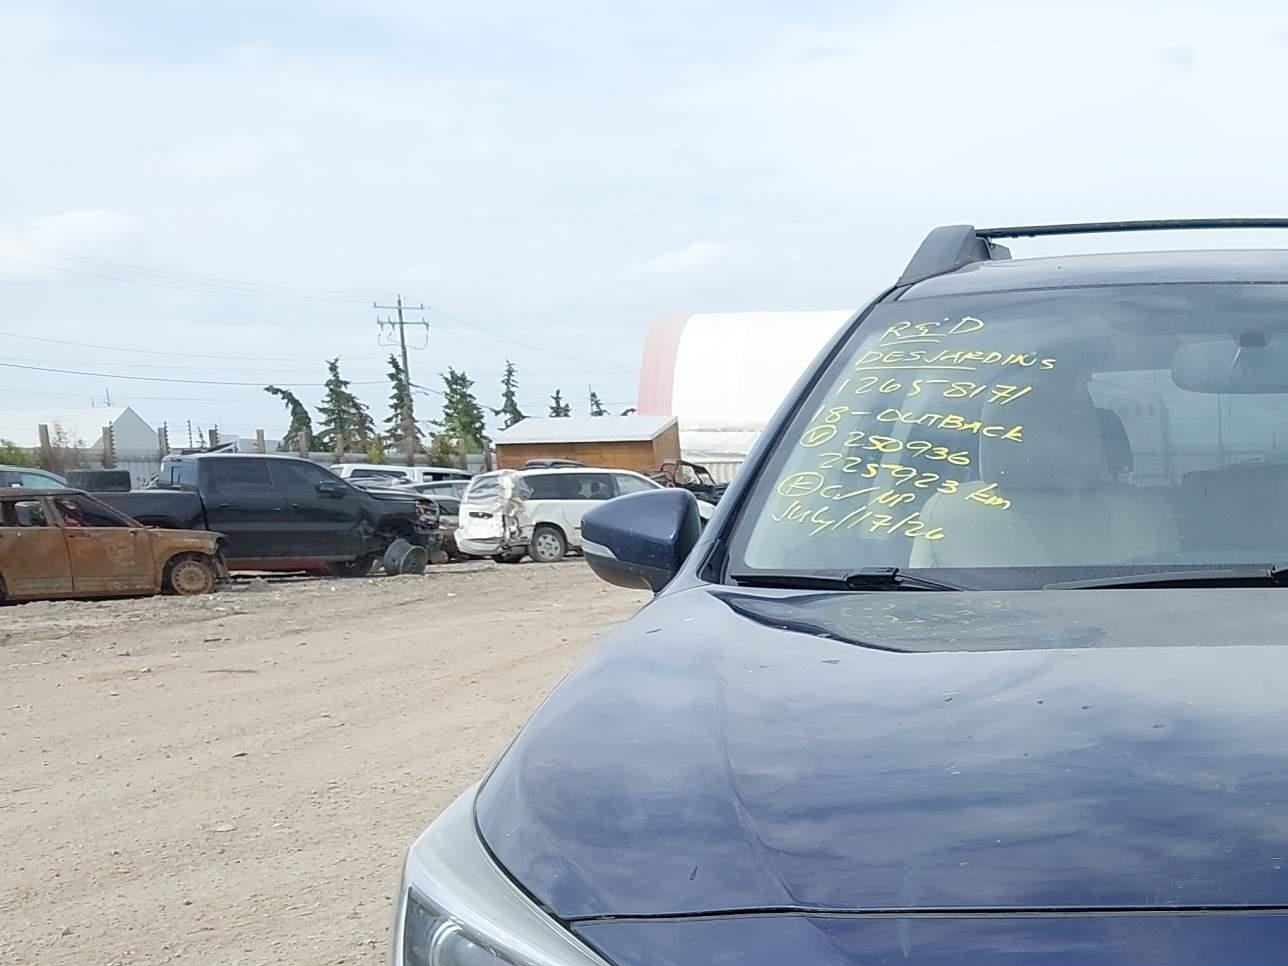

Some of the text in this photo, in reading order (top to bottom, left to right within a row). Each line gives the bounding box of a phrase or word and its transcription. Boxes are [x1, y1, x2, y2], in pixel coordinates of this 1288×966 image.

[856, 349, 1057, 371] DESJARDINS
[836, 376, 1033, 405] 12658171
[844, 431, 971, 465] 250936
[819, 452, 959, 494] 225923
